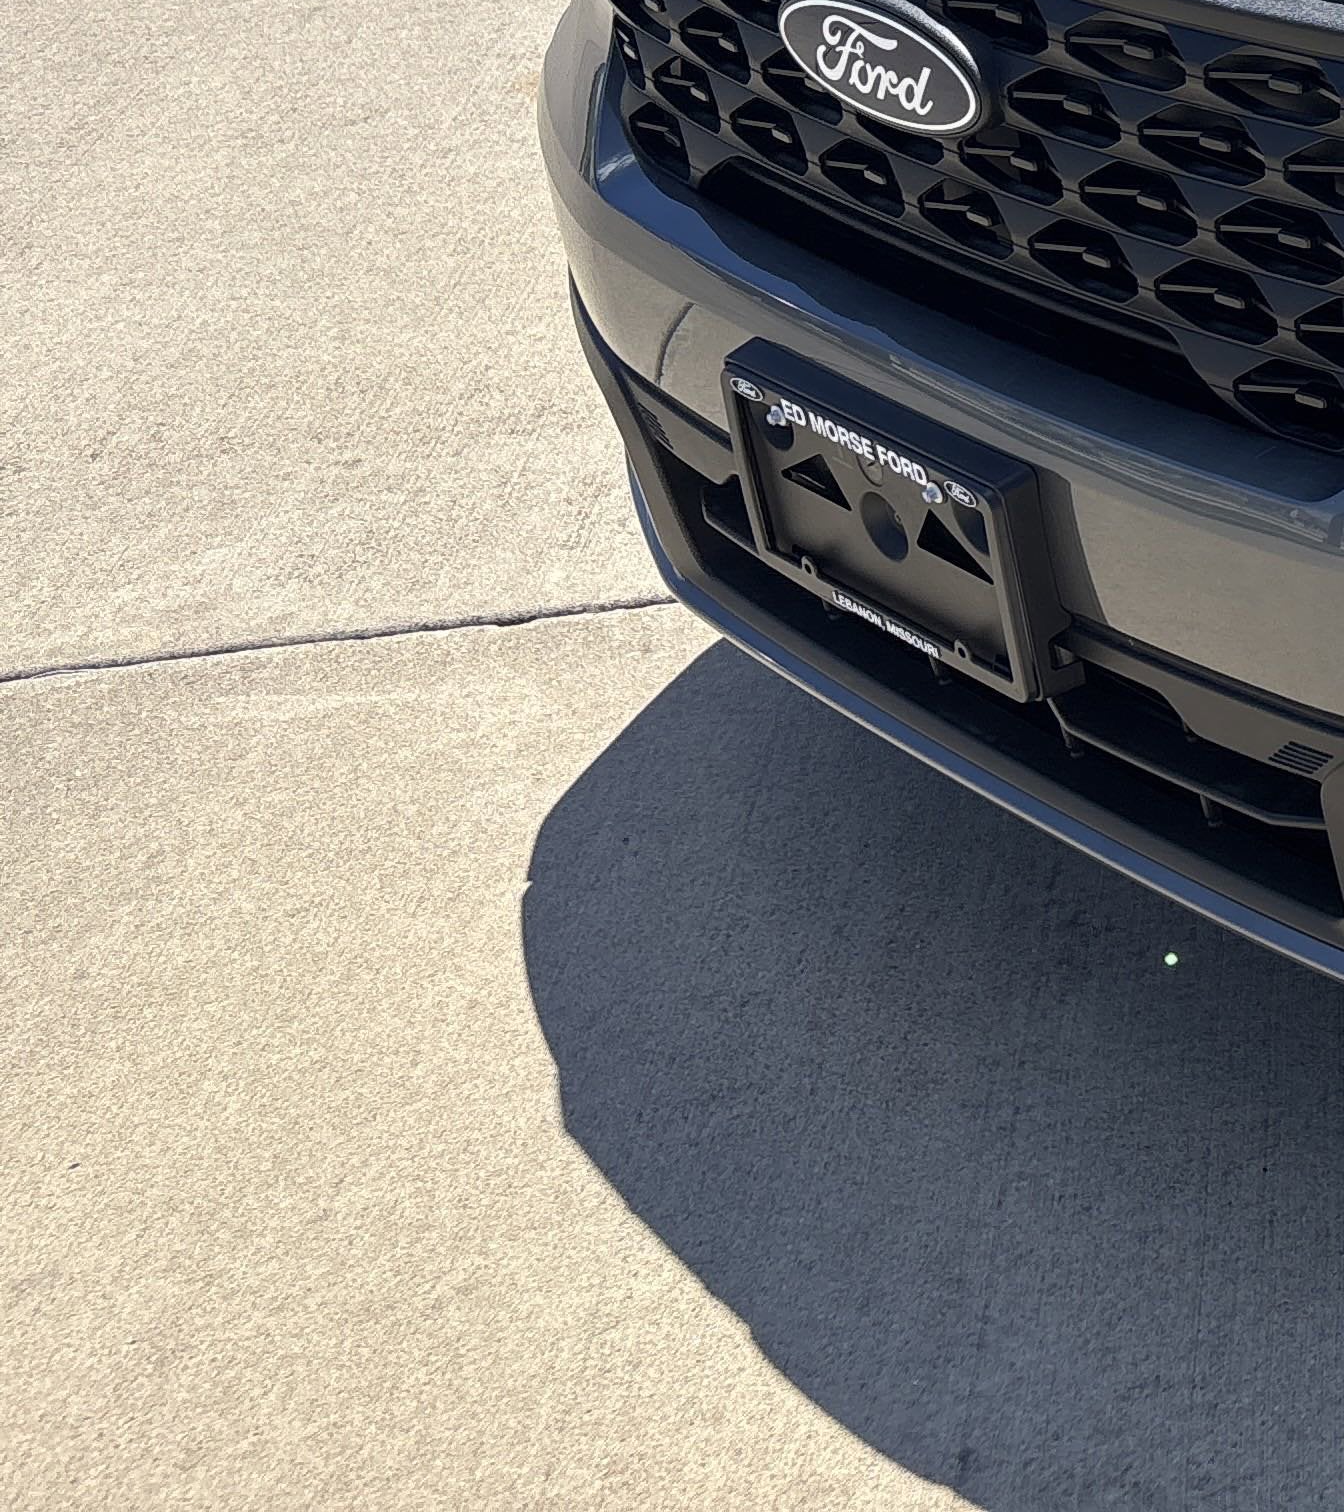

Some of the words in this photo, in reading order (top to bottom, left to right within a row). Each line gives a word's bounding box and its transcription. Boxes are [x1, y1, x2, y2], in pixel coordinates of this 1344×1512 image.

[816, 14, 934, 116] Ford
[780, 398, 807, 427] ED
[808, 411, 876, 461] MORSE
[875, 444, 928, 486] FORD
[832, 591, 886, 631] LEBANON,
[885, 620, 940, 659] MISSOURI
